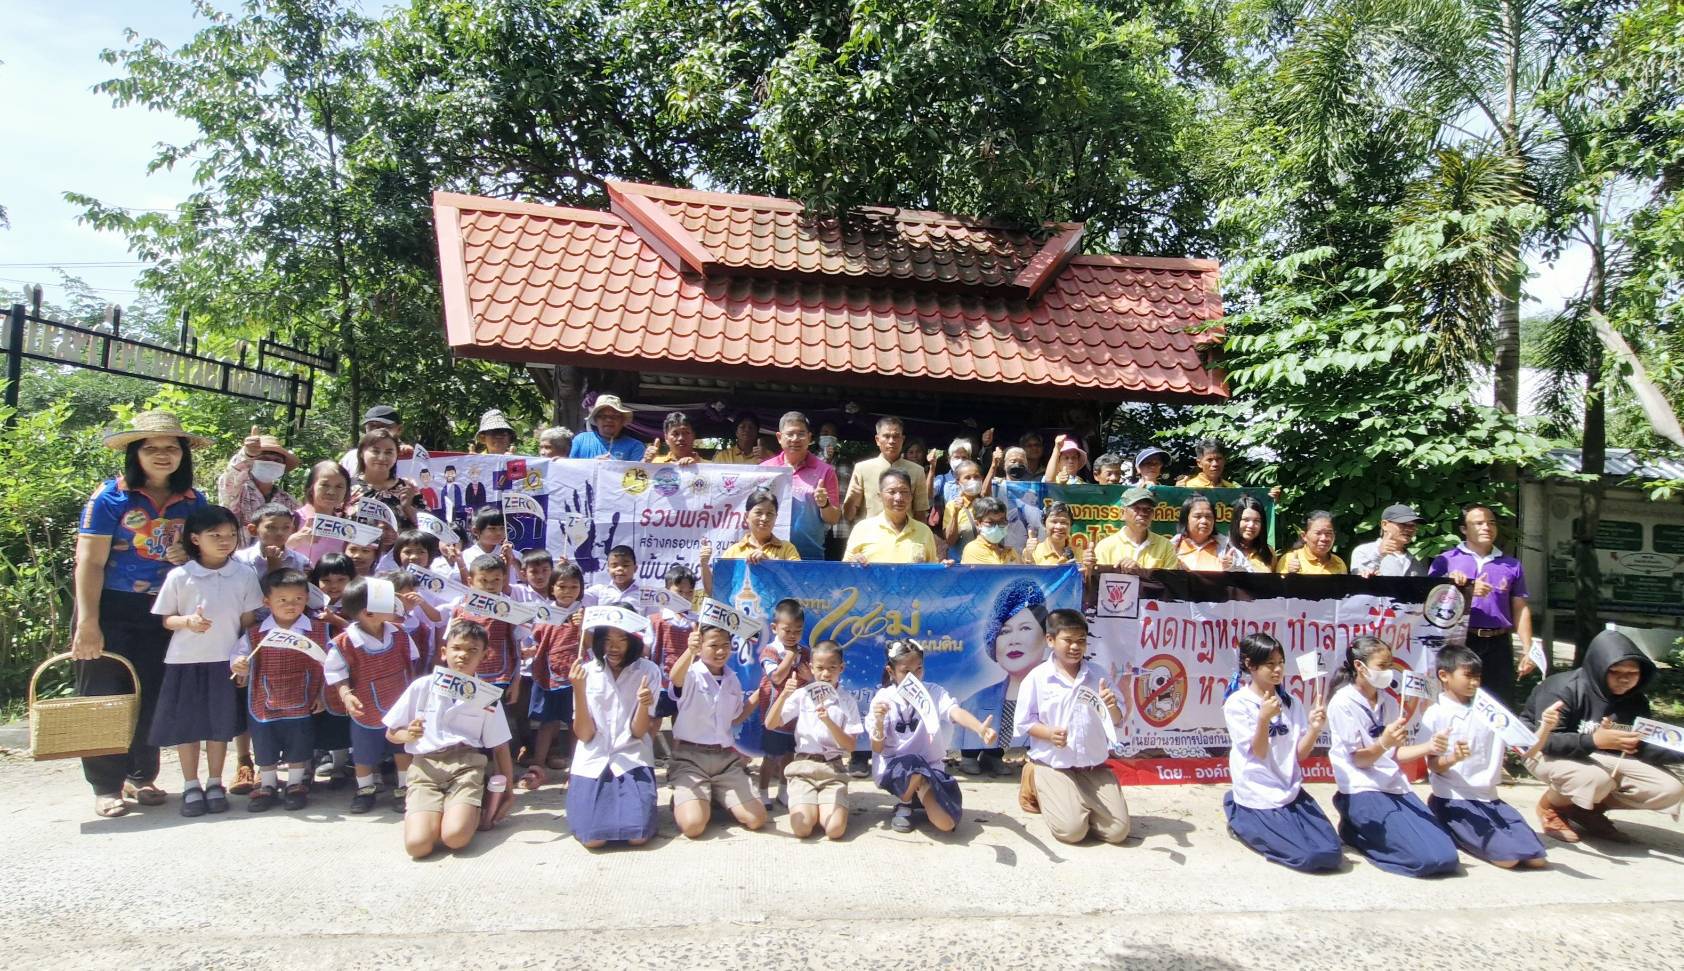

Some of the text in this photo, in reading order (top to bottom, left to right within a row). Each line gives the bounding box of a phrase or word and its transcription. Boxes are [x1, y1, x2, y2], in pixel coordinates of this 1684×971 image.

[360, 500, 391, 521] ZERO
[504, 496, 537, 513] ZERO
[315, 517, 358, 539] ZERO
[408, 567, 444, 592] ZERO
[468, 593, 511, 617] ZERO
[640, 588, 671, 605] ZERO
[703, 602, 741, 630] ZERO
[267, 630, 312, 651] ZERO
[434, 671, 477, 699] ZERO
[903, 679, 931, 713] ZERO
[1639, 721, 1683, 747] ZERO
